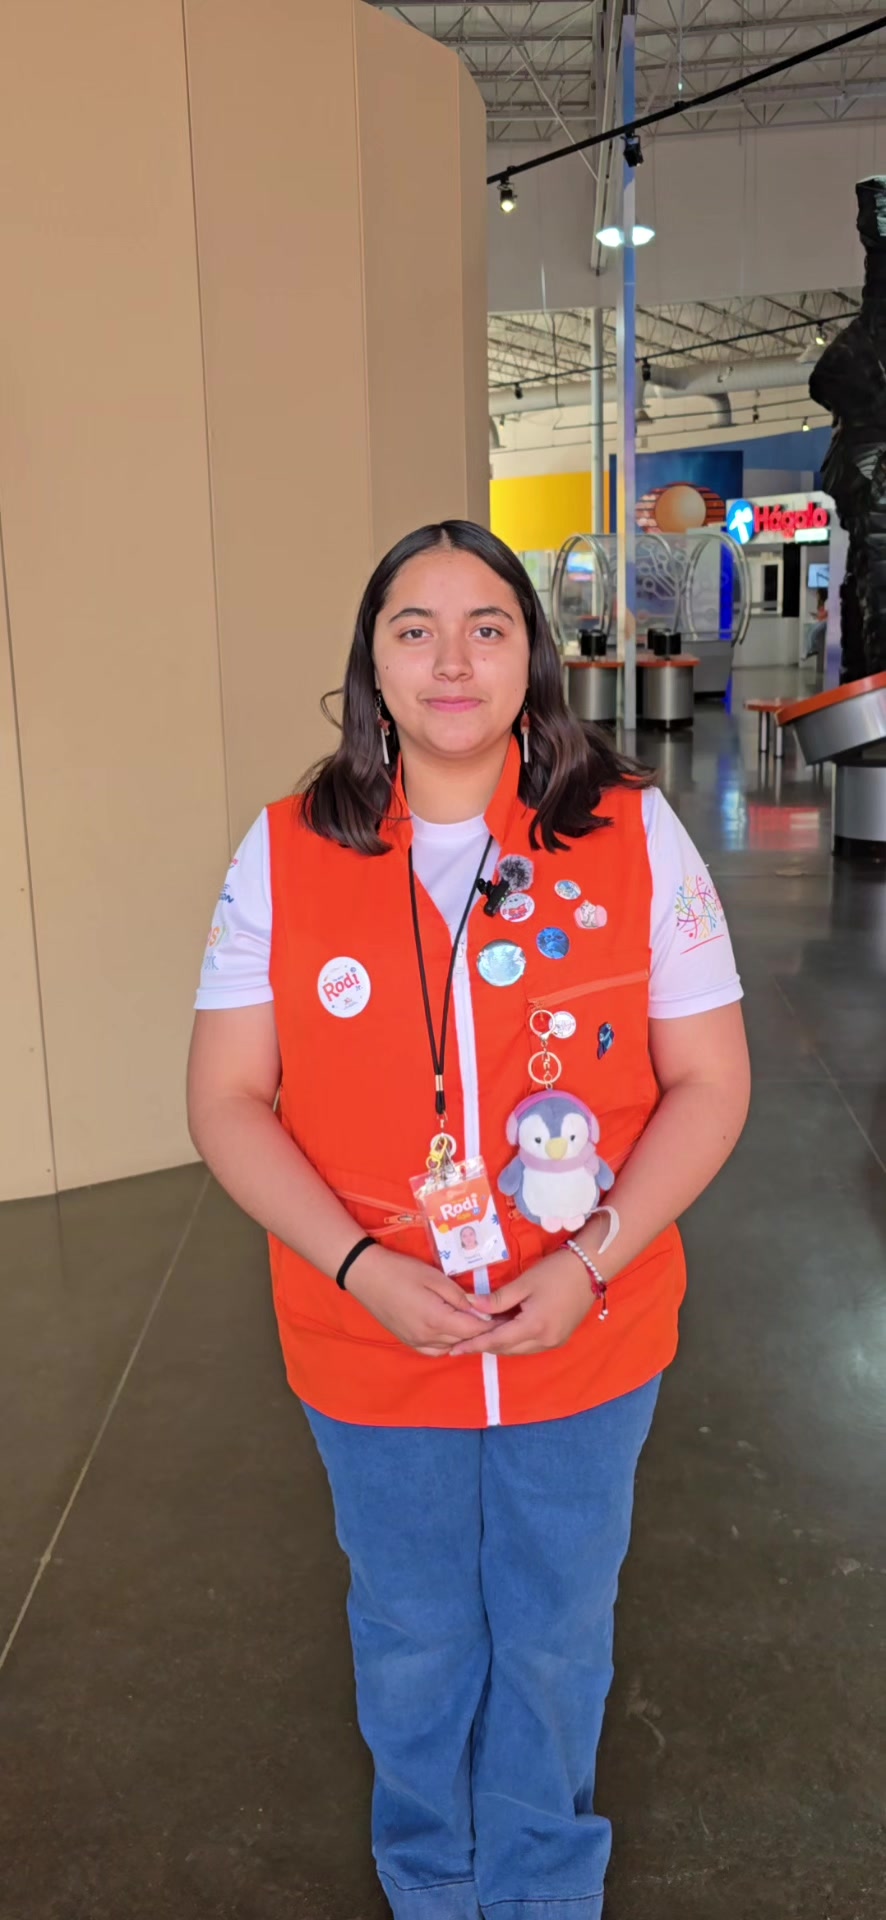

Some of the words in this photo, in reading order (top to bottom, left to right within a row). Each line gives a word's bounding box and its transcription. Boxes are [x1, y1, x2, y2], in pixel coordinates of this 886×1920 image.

[754, 501, 828, 538] Hágalo
[323, 972, 360, 1002] Rodi
[440, 1193, 478, 1221] Rodi
